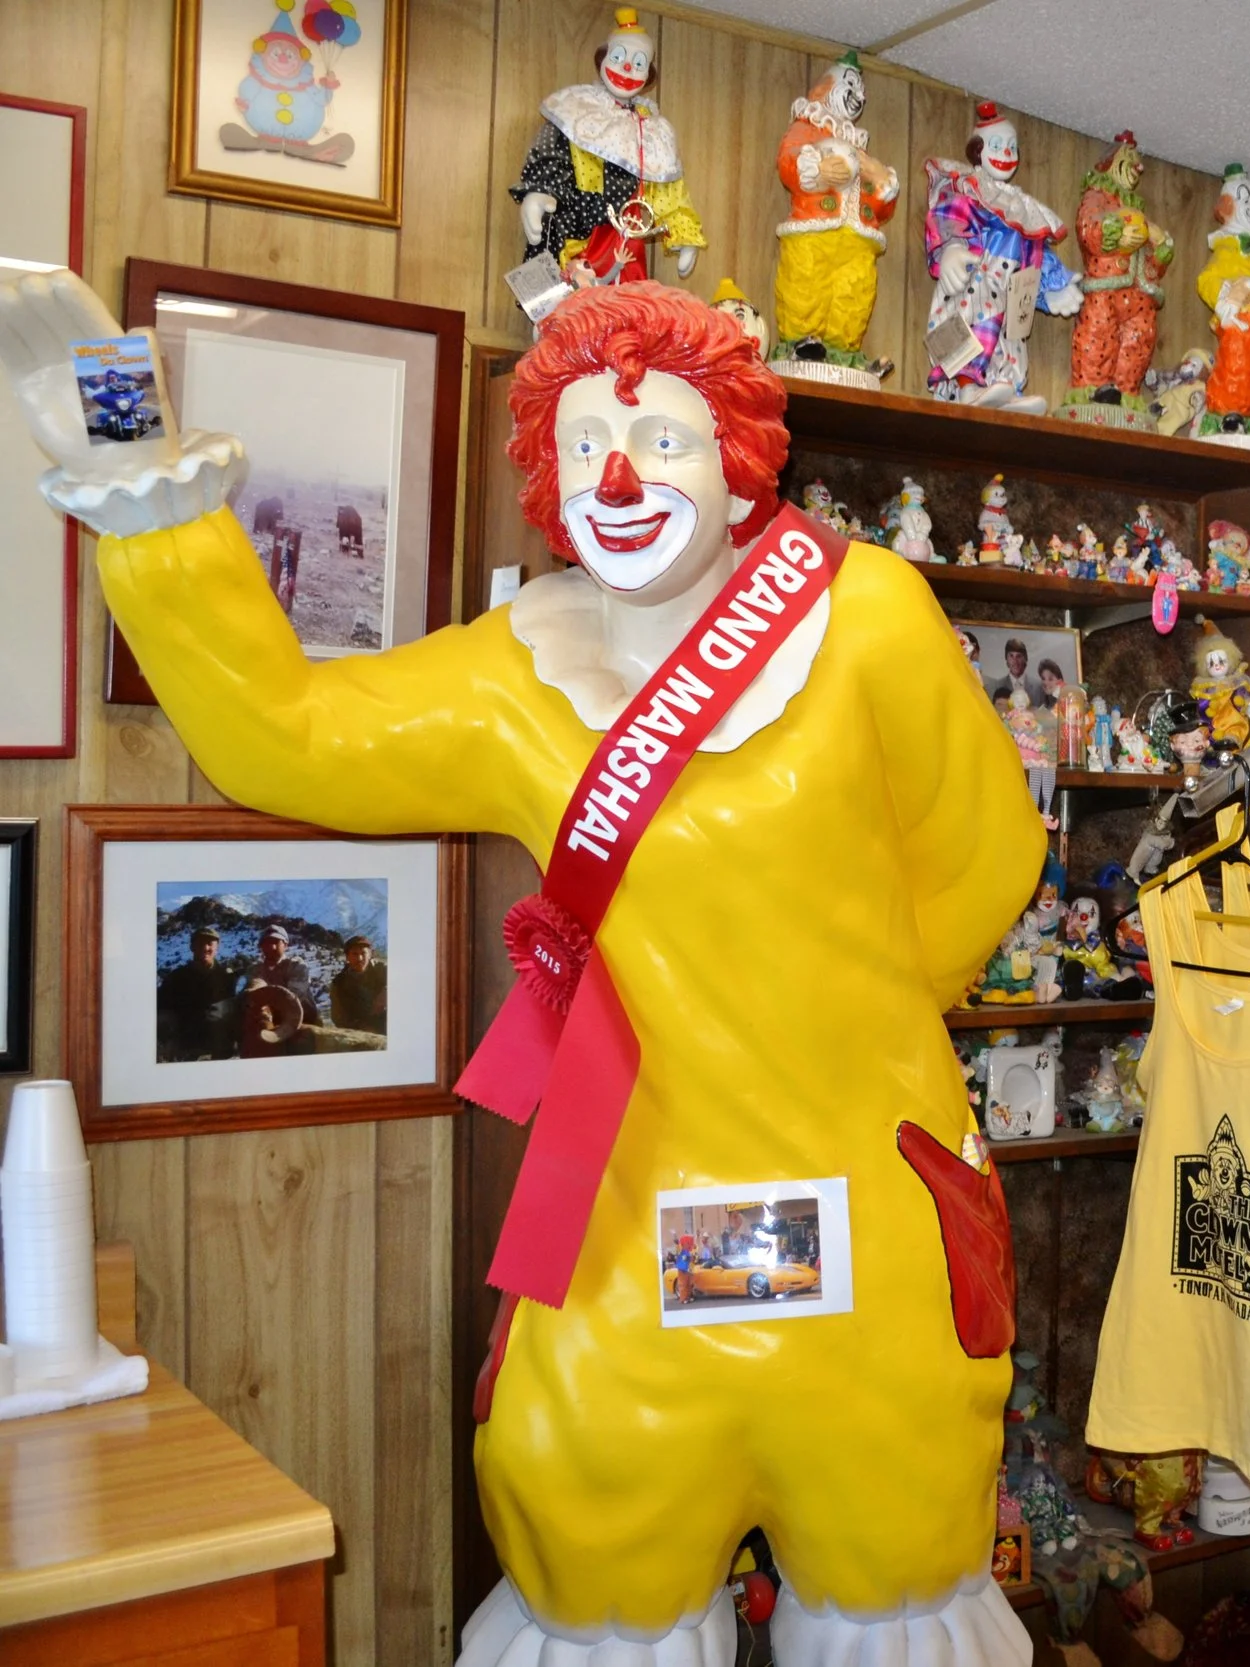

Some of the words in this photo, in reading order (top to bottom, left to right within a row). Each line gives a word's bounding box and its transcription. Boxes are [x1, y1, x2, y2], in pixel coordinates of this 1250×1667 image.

[698, 530, 824, 671] GRAND
[567, 664, 715, 862] MARSHAL
[535, 944, 561, 974] 2015
